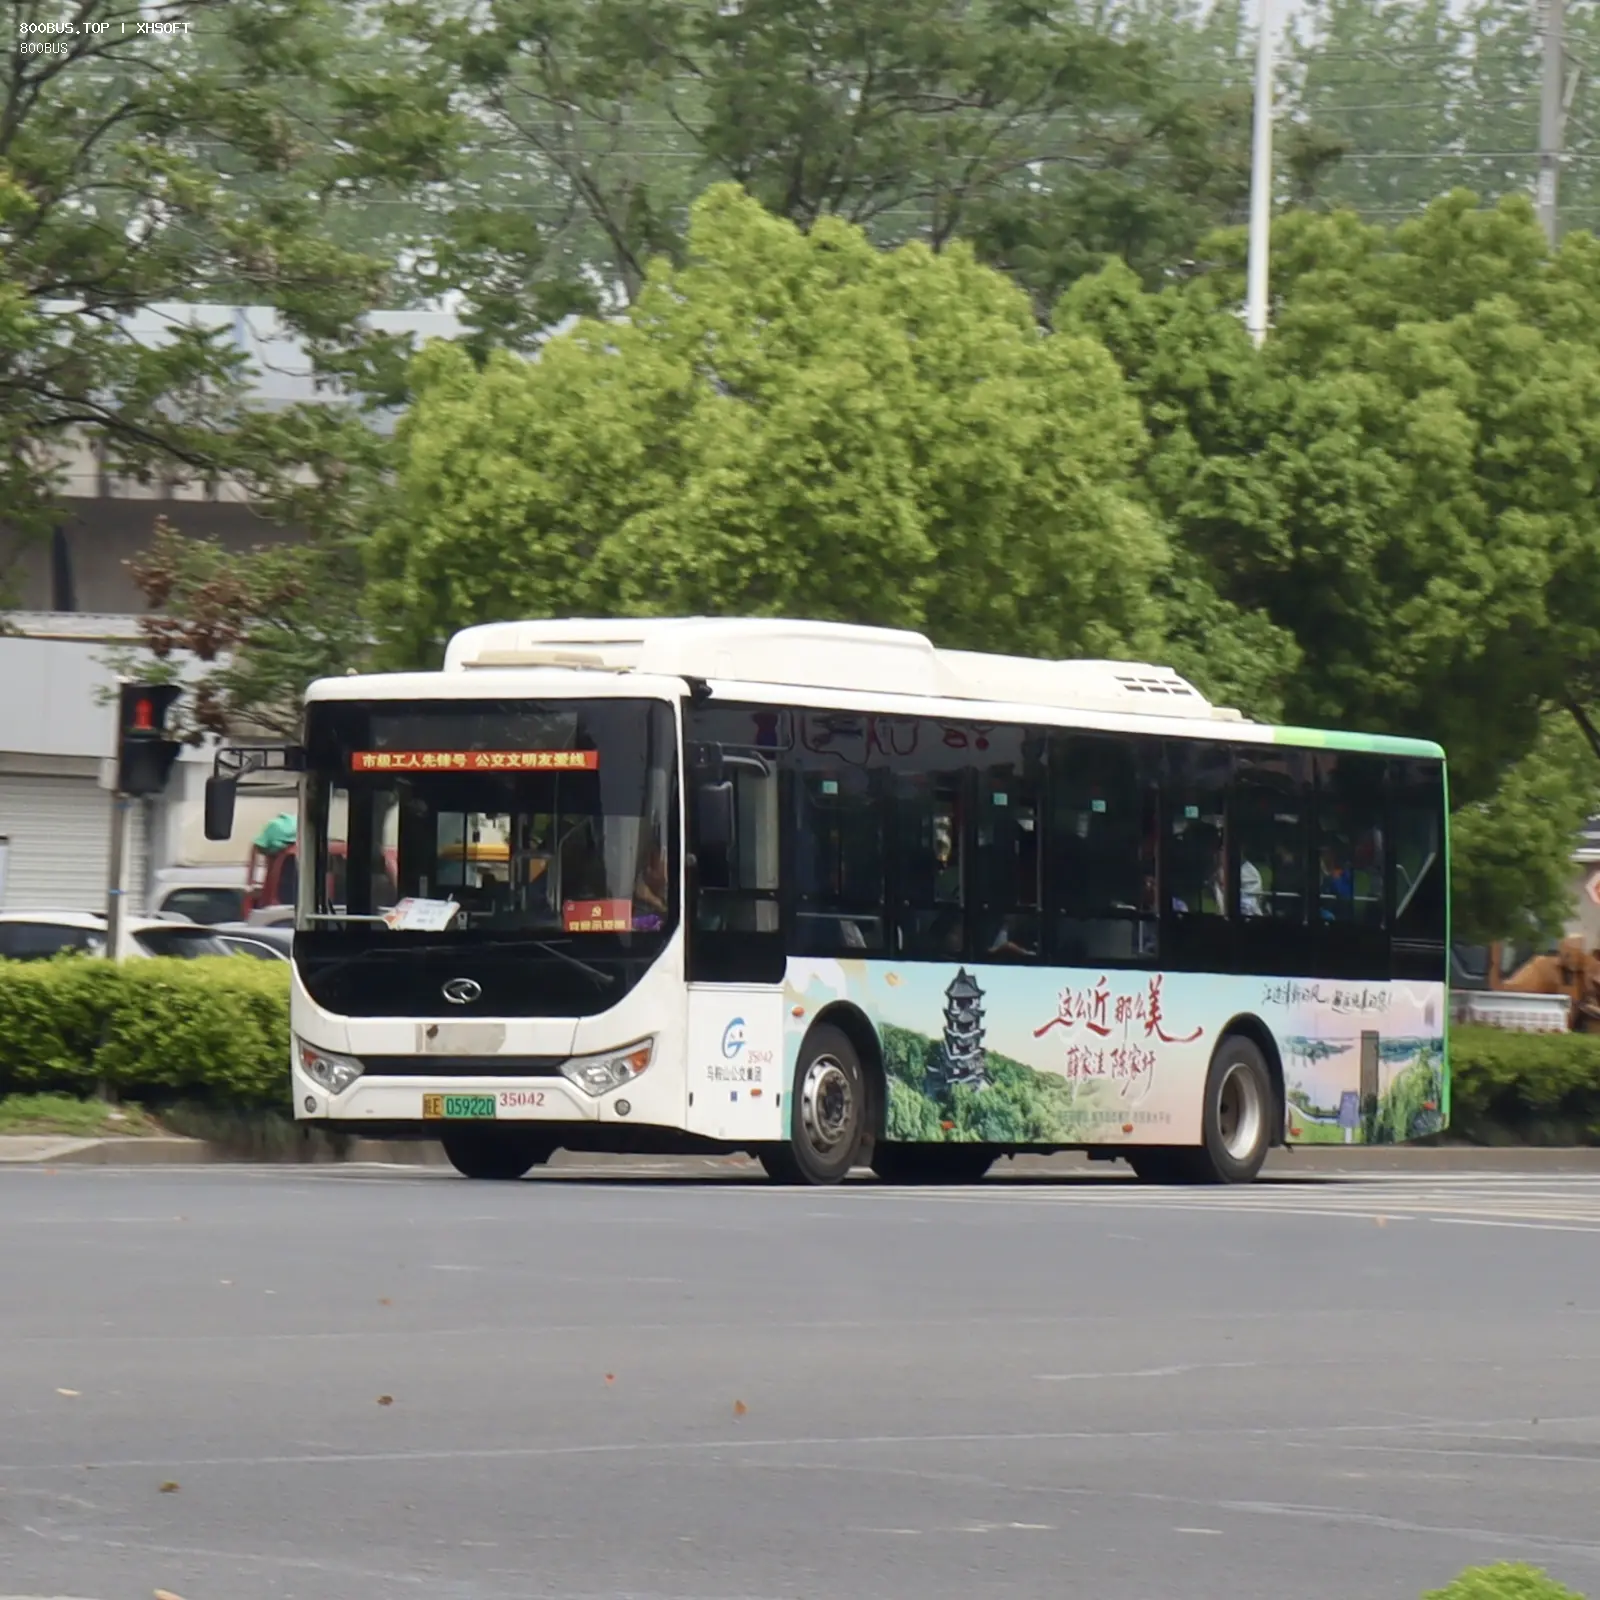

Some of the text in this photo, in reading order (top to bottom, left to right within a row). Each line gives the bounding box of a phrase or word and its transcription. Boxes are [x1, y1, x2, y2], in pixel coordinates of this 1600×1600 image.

[362, 753, 466, 768] 市级工人先锋号
[499, 1092, 546, 1107] 35042
